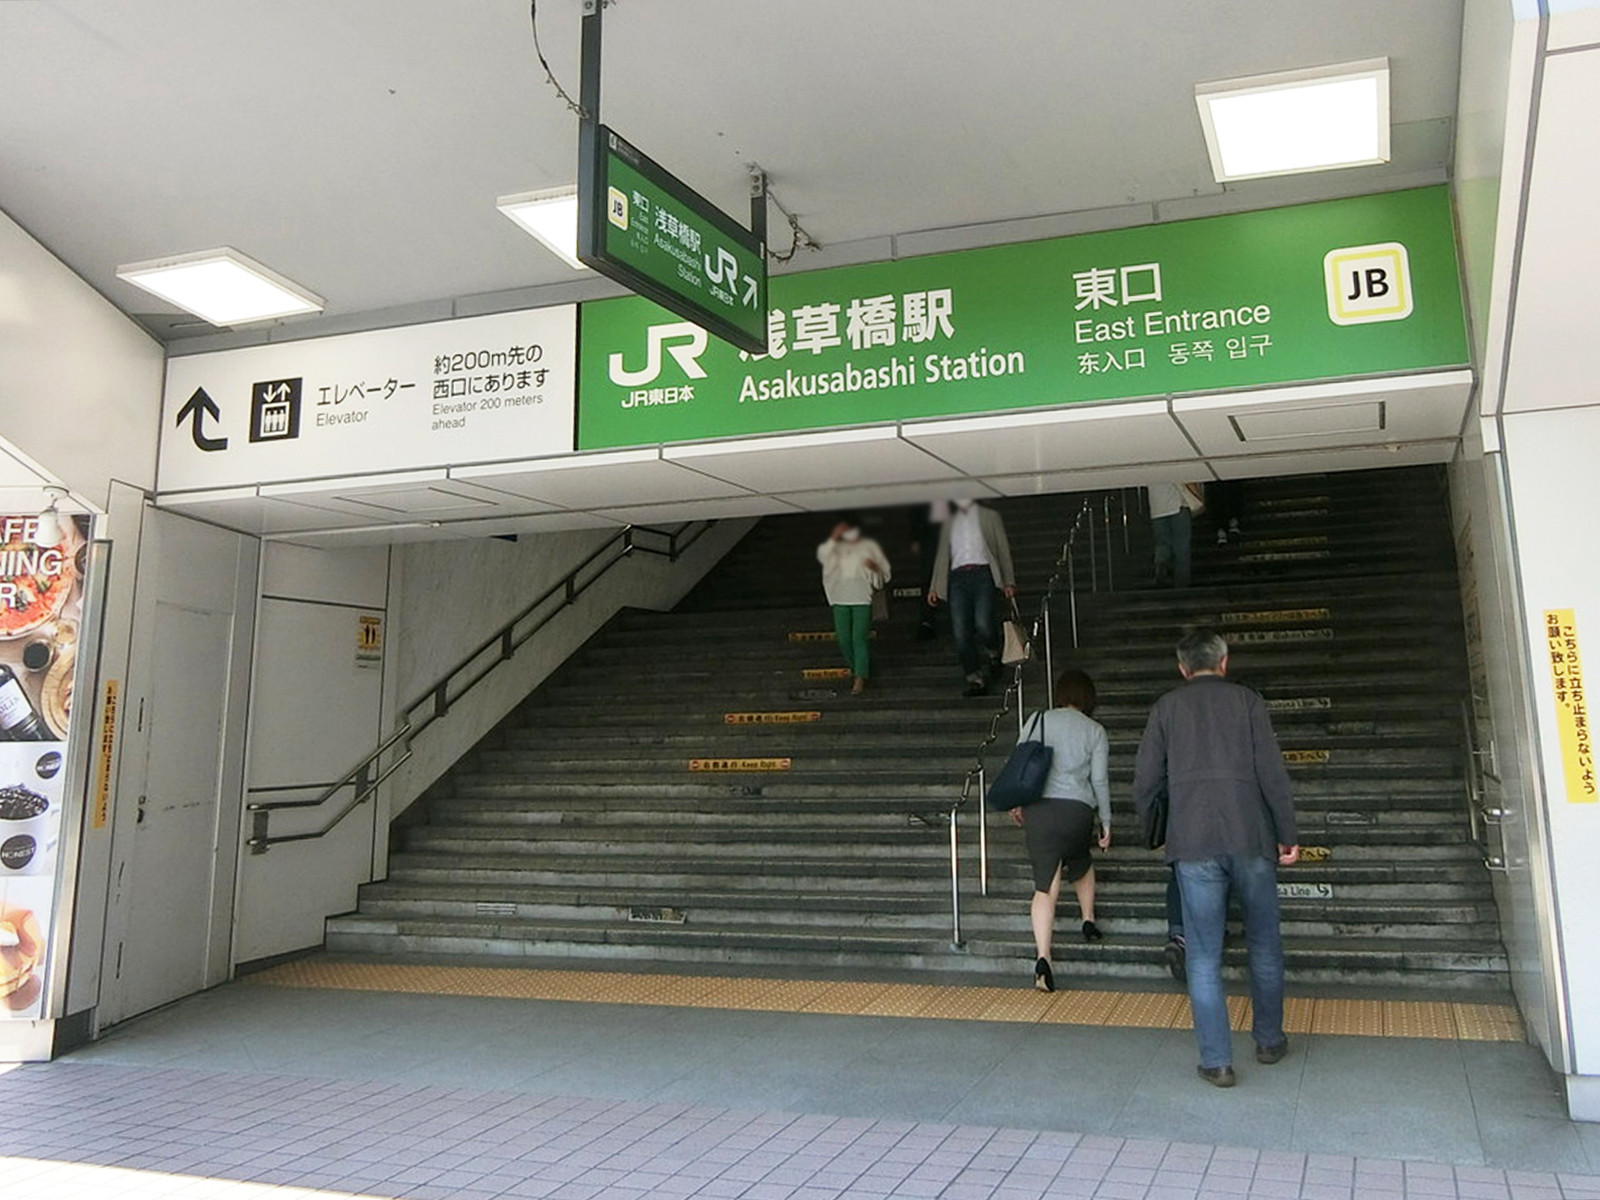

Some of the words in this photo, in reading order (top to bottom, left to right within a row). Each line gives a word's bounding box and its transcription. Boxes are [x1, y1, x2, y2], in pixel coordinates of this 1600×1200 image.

[612, 199, 624, 217] JB
[654, 205, 701, 254] 浅草橋駅
[704, 246, 738, 296] JR
[1072, 262, 1163, 311] 東口
[1347, 267, 1390, 301] JB
[1074, 317, 1136, 345] East
[1143, 303, 1271, 337] Entrance
[434, 343, 544, 376] 約200m先の
[608, 321, 709, 387] JR
[1077, 347, 1147, 376] 东入口
[1168, 341, 1215, 366] 동쪽
[1225, 334, 1274, 359] 입구
[316, 376, 417, 407] エレベーター
[432, 367, 551, 401] 西口にあります
[738, 357, 916, 403] Asakusabashi
[924, 347, 1026, 385] Station
[432, 400, 477, 416] Elevator
[480, 397, 502, 410] 200
[504, 393, 545, 408] meters
[621, 384, 695, 409] JR東日本
[316, 408, 370, 427] Elevator
[431, 417, 467, 431] ahead
[0, 518, 39, 543] FE
[1563, 625, 1596, 795] こちらに立ち止まらないよう
